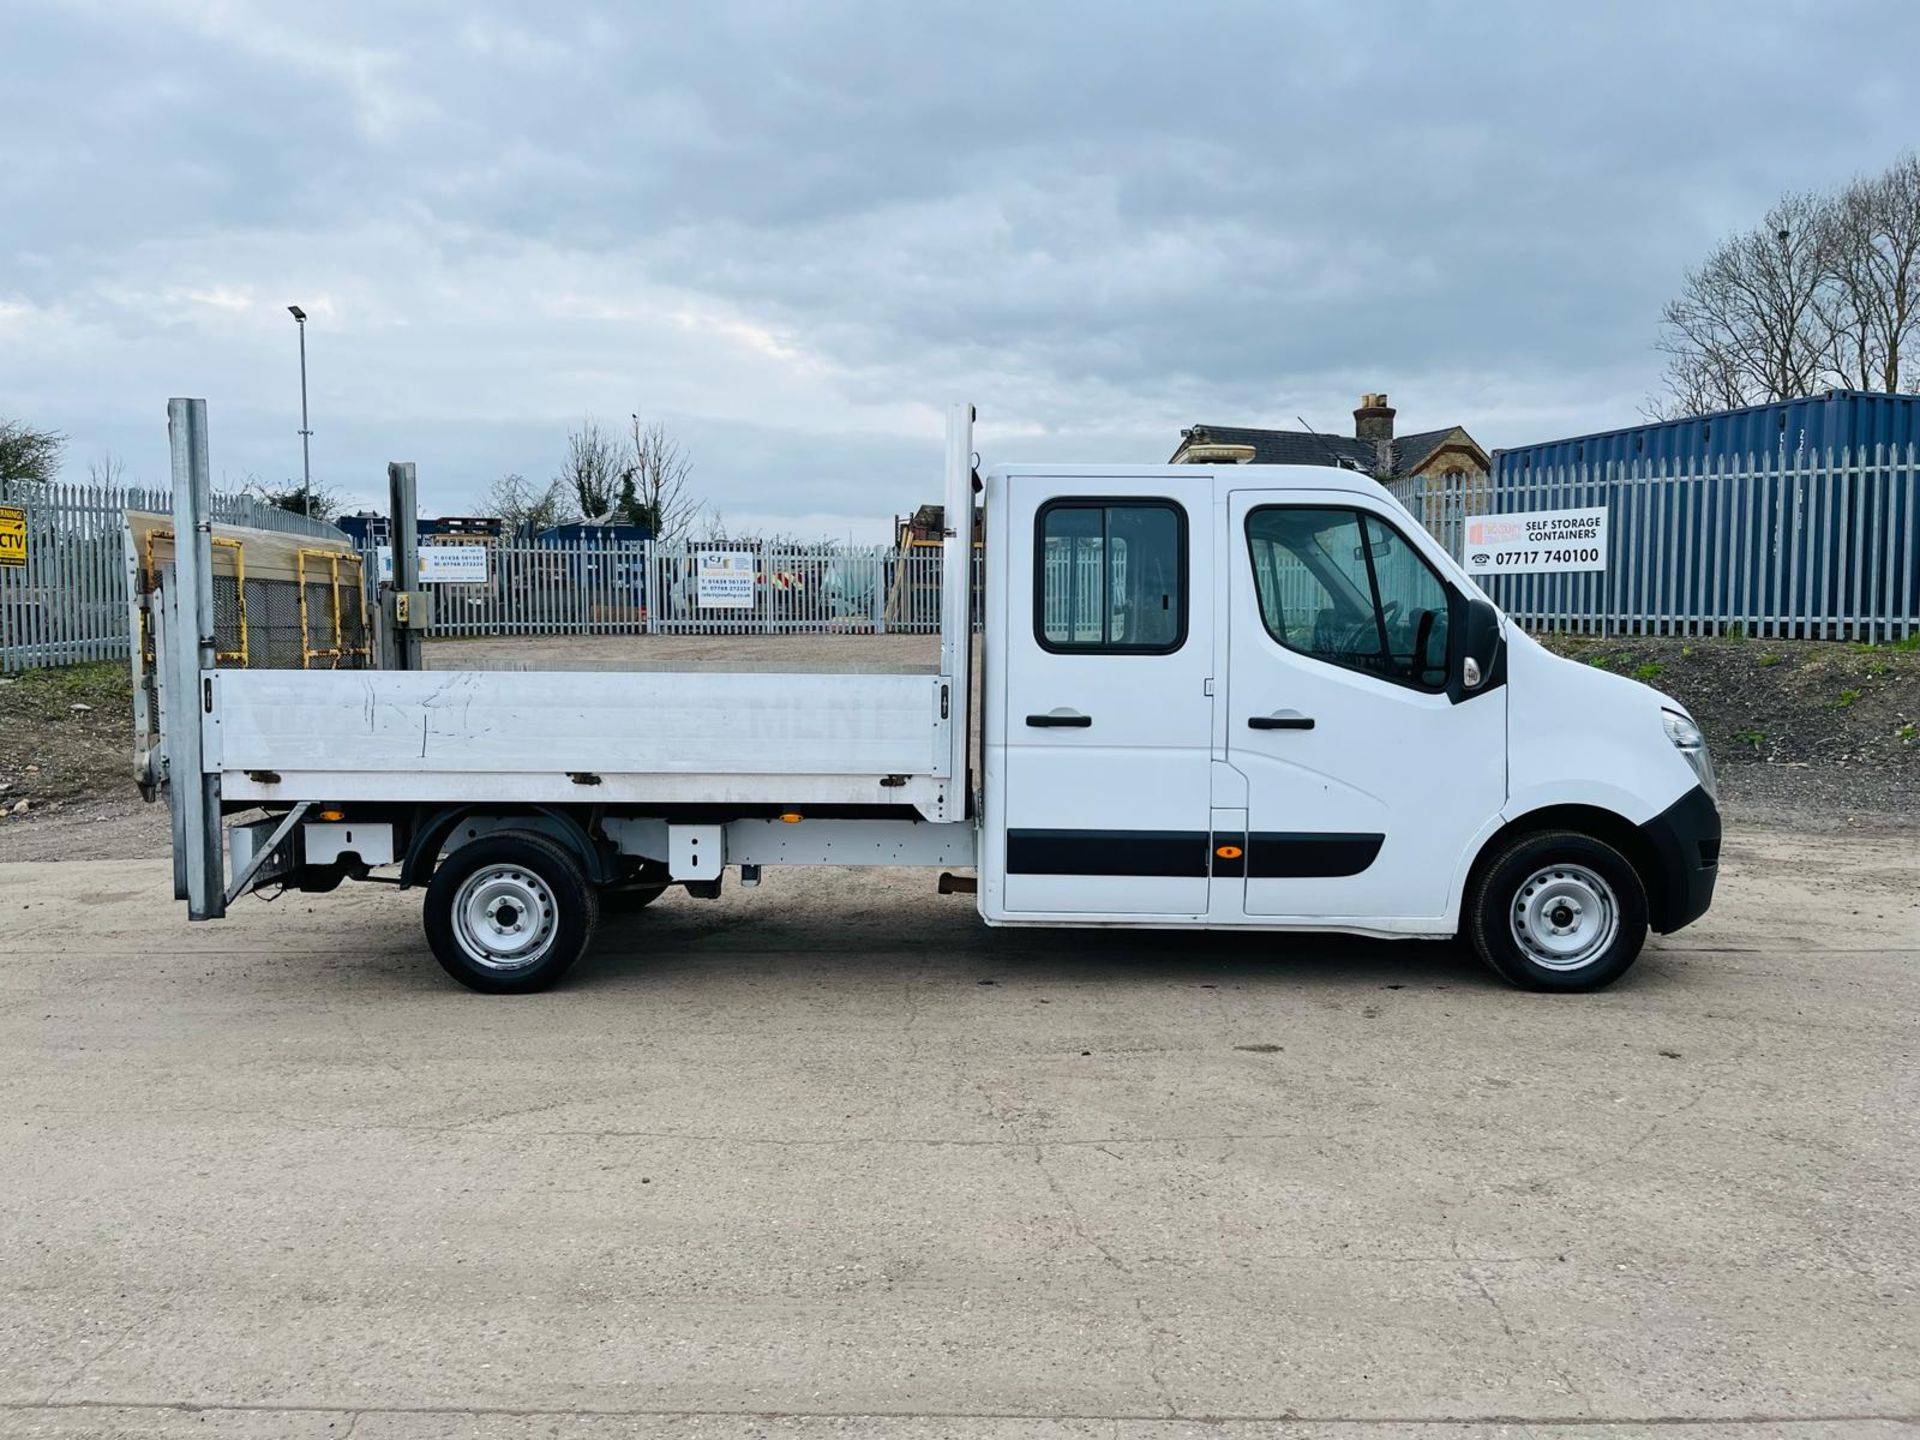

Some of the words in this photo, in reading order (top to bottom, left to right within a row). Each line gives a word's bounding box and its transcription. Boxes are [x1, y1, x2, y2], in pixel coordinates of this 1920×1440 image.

[1526, 520, 1548, 531] SELF
[1551, 517, 1601, 529] STORAGE
[1528, 529, 1597, 542] CONTAINERS
[1496, 551, 1539, 565] 07717
[1544, 548, 1599, 563] 740100
